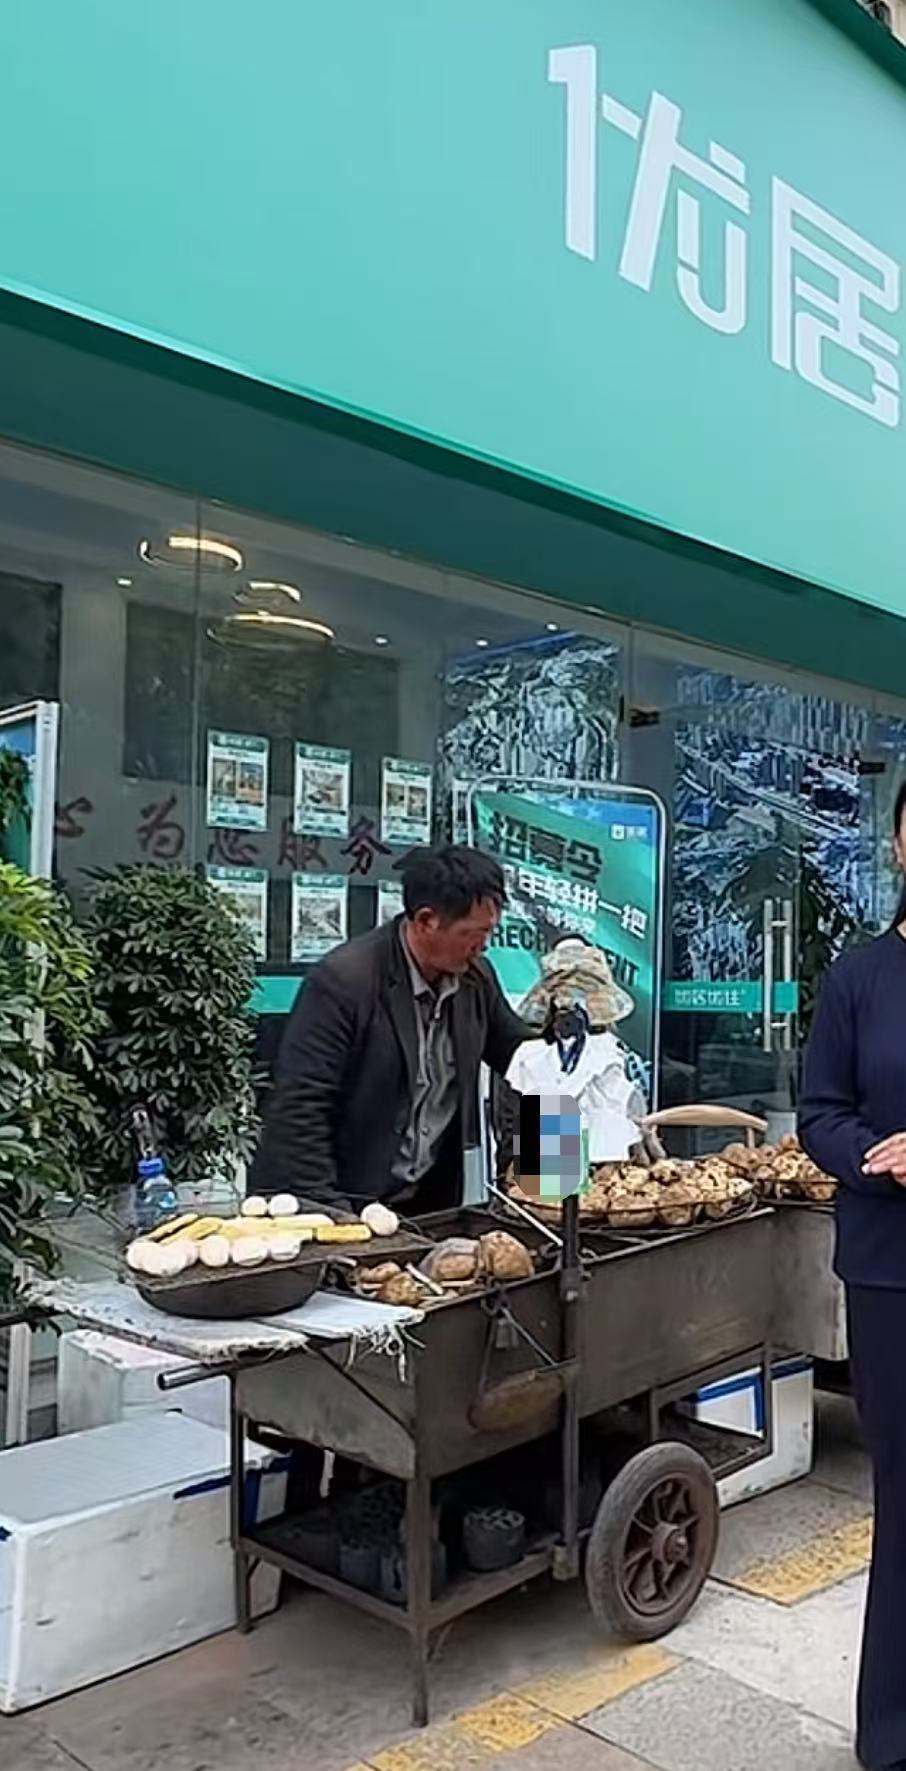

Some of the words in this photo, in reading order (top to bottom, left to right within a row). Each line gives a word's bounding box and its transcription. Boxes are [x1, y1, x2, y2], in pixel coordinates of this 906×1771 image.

[548, 44, 901, 428] 优居
[488, 810, 602, 885] 招募令
